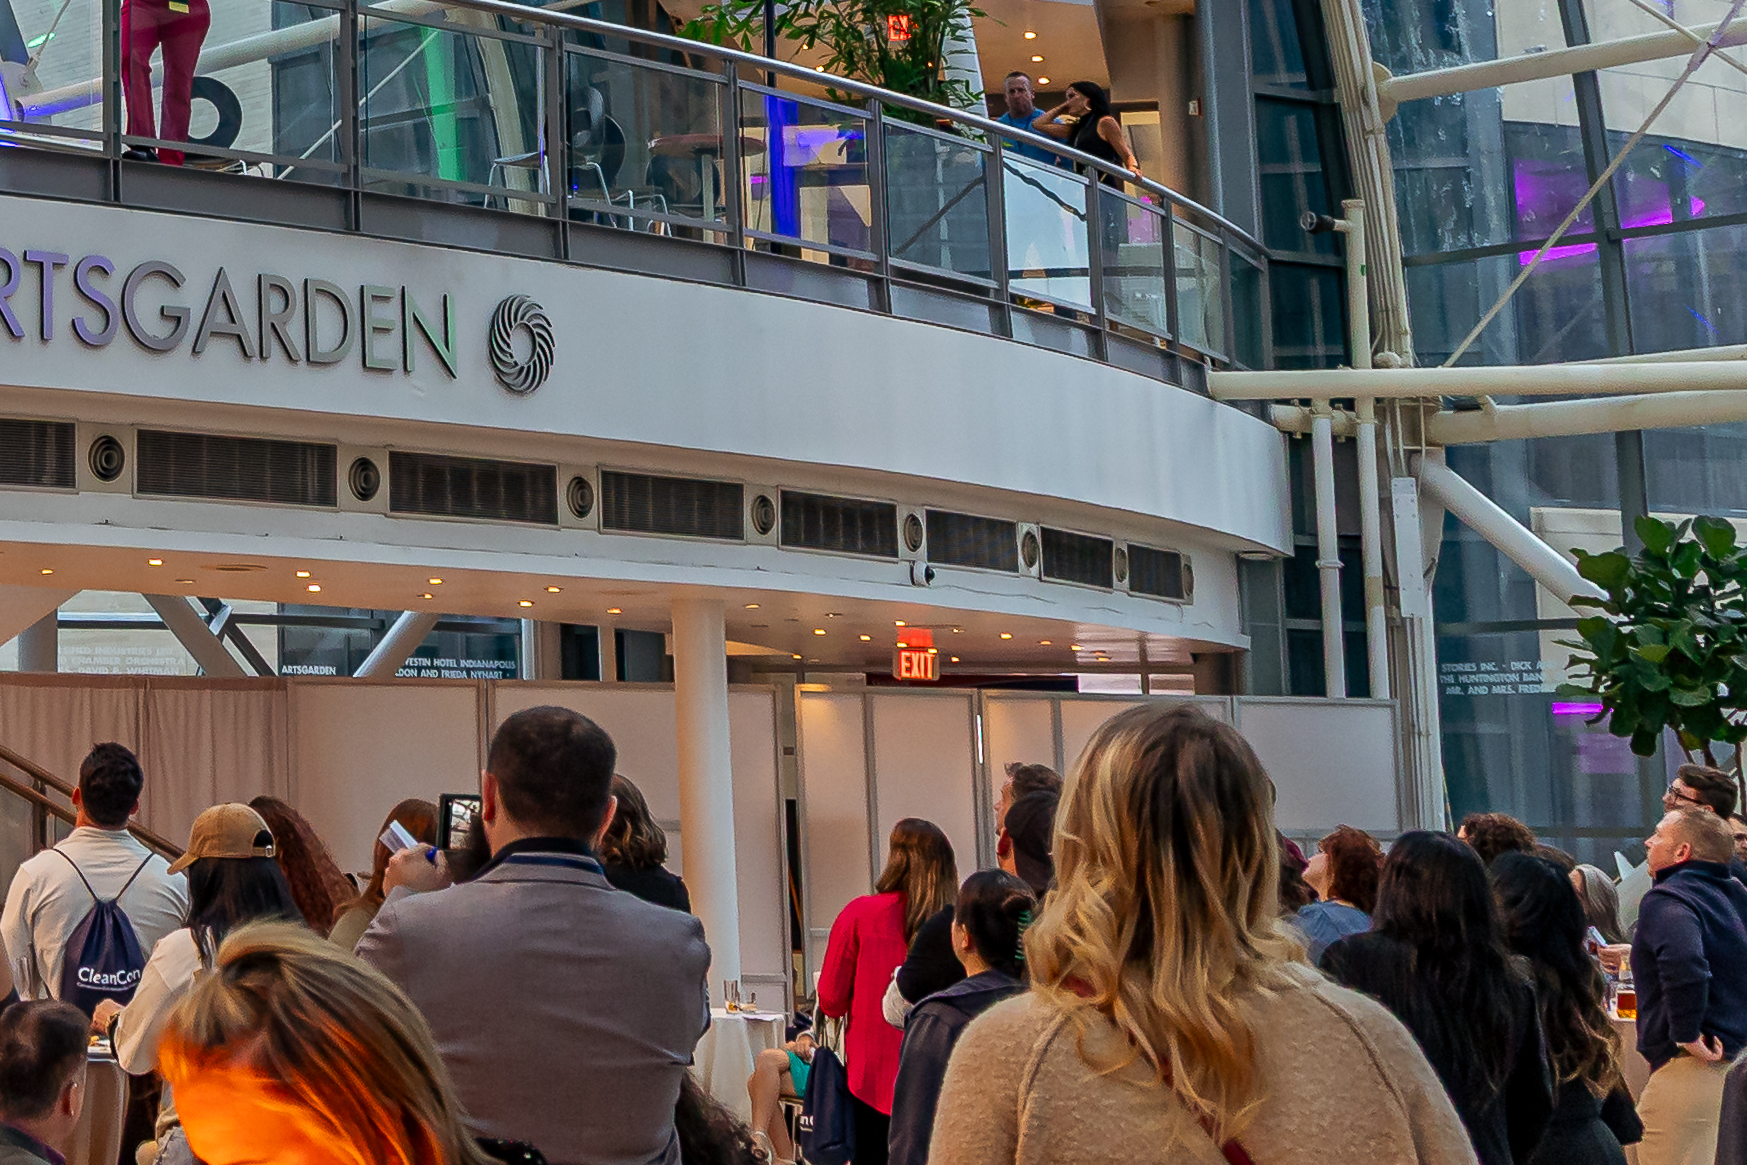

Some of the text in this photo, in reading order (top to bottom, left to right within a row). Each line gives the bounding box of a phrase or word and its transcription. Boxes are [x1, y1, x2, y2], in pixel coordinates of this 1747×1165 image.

[433, 659, 458, 668] HOTEL
[460, 659, 516, 670] INDIANAPOLIS
[900, 651, 936, 680] EXIT
[1510, 660, 1532, 671] DICK
[282, 665, 337, 676] ARTSGARDEN
[420, 669, 439, 679] AND
[1467, 685, 1489, 695] AND
